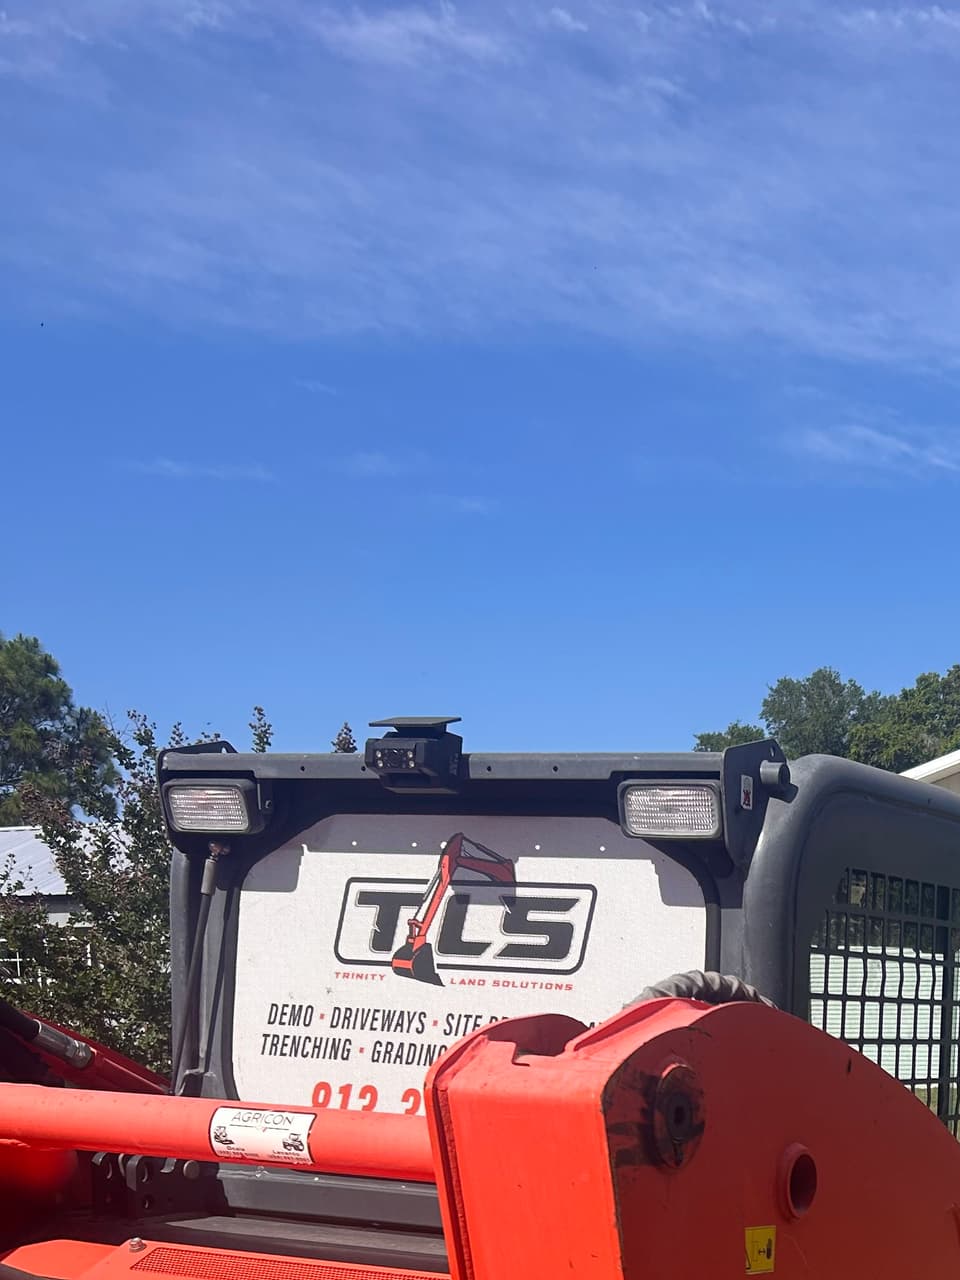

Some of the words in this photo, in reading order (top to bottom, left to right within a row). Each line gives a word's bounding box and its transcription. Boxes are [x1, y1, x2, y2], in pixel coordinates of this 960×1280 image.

[355, 890, 581, 962] TLS
[334, 971, 386, 982] TRINITY
[450, 977, 486, 987] LAND
[492, 979, 574, 991] SOLUTIONS
[267, 1003, 315, 1027] DEMO
[330, 1006, 427, 1034] DRIVEWAYS
[443, 1013, 483, 1037] SITE
[260, 1033, 352, 1061] TRENCHING
[231, 1111, 295, 1126] AGRICON
